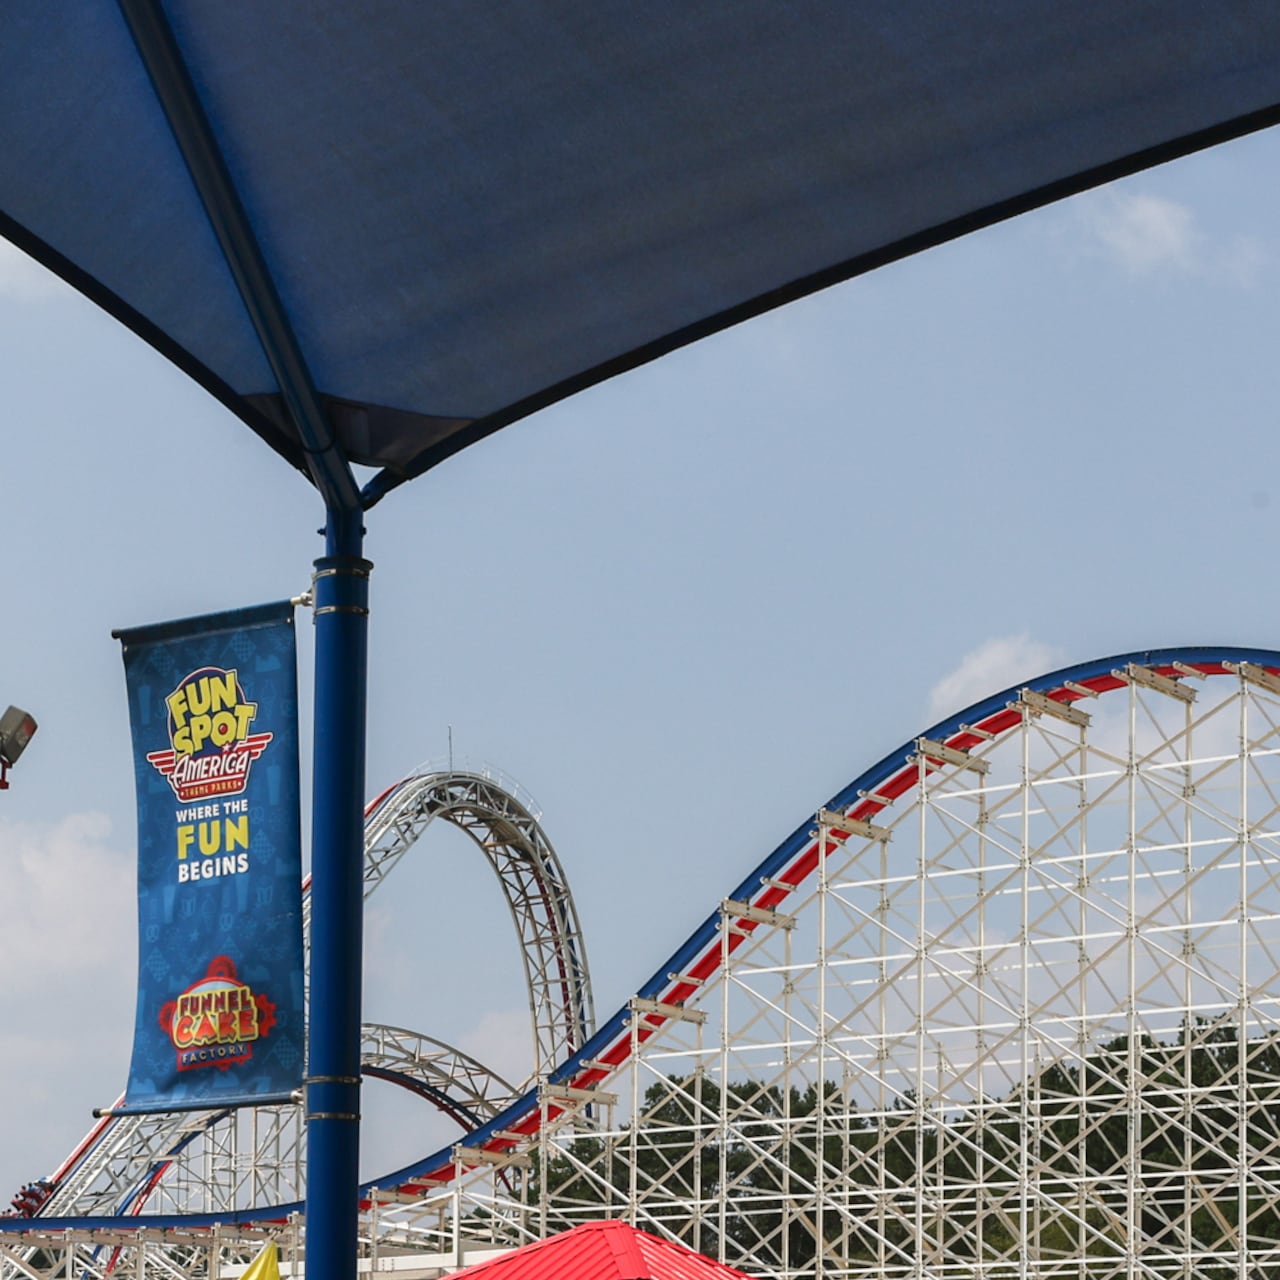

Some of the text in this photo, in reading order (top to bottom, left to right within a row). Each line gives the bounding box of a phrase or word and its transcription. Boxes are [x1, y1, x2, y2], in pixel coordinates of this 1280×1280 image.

[168, 671, 237, 728] FUN
[173, 704, 255, 760] SPOT
[171, 751, 250, 786] AMERICA
[184, 781, 238, 797] THEME PARKS
[175, 799, 249, 823] WHERE THE
[176, 815, 250, 860] FUN
[178, 853, 250, 883] BEGINS
[179, 988, 252, 1018] FUNNEL
[175, 1009, 256, 1045] CAKE
[182, 1044, 246, 1064] FACTORY
